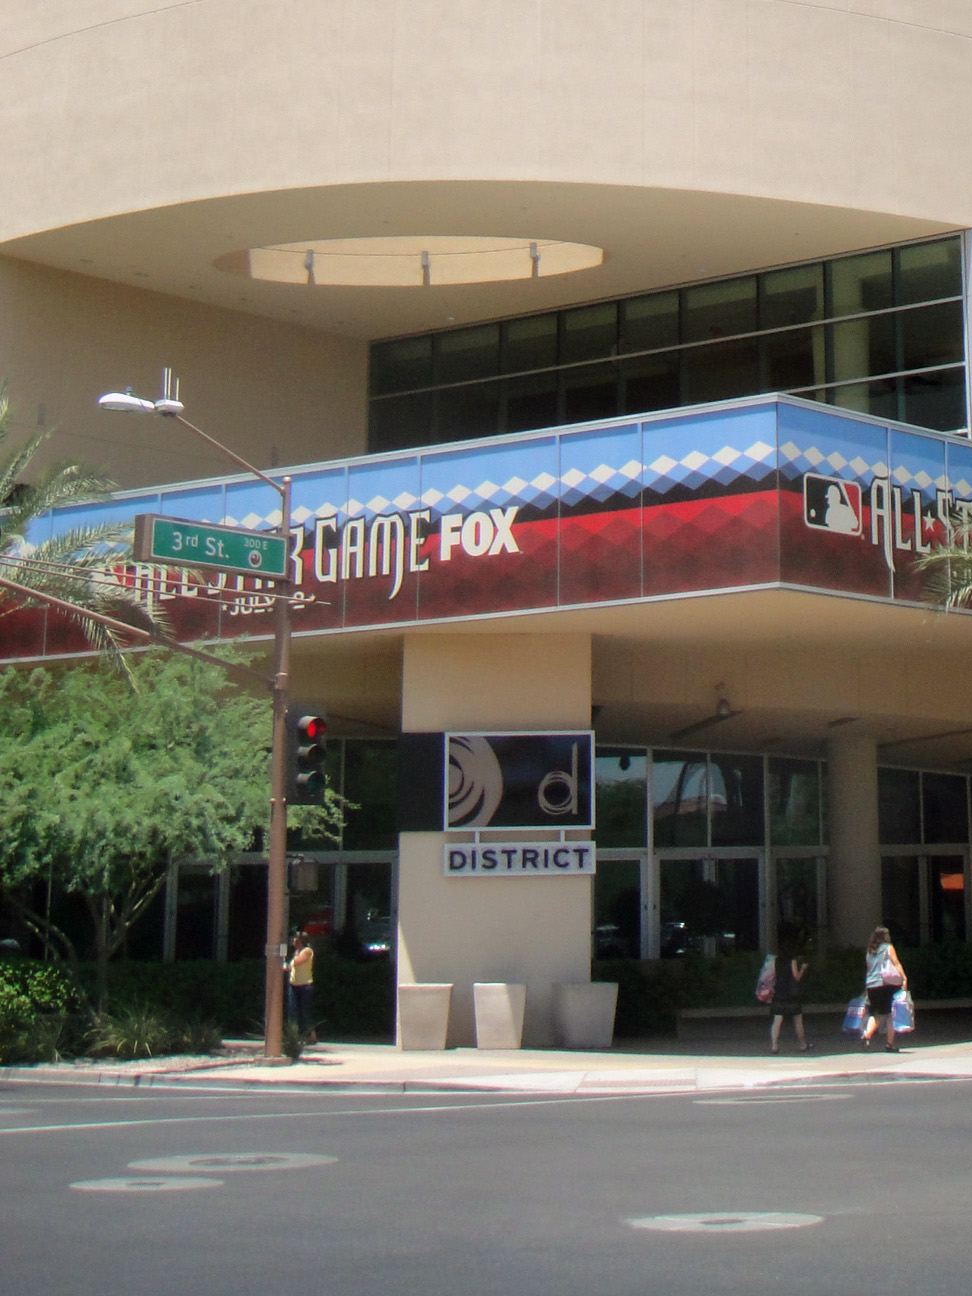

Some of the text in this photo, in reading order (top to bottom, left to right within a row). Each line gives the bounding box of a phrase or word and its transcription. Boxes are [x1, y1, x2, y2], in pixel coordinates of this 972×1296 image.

[171, 531, 230, 559] 3rd St.
[314, 510, 432, 600] GAME
[440, 506, 520, 561] FOX
[870, 476, 931, 572] ALL
[450, 848, 589, 871] DISTRICT
